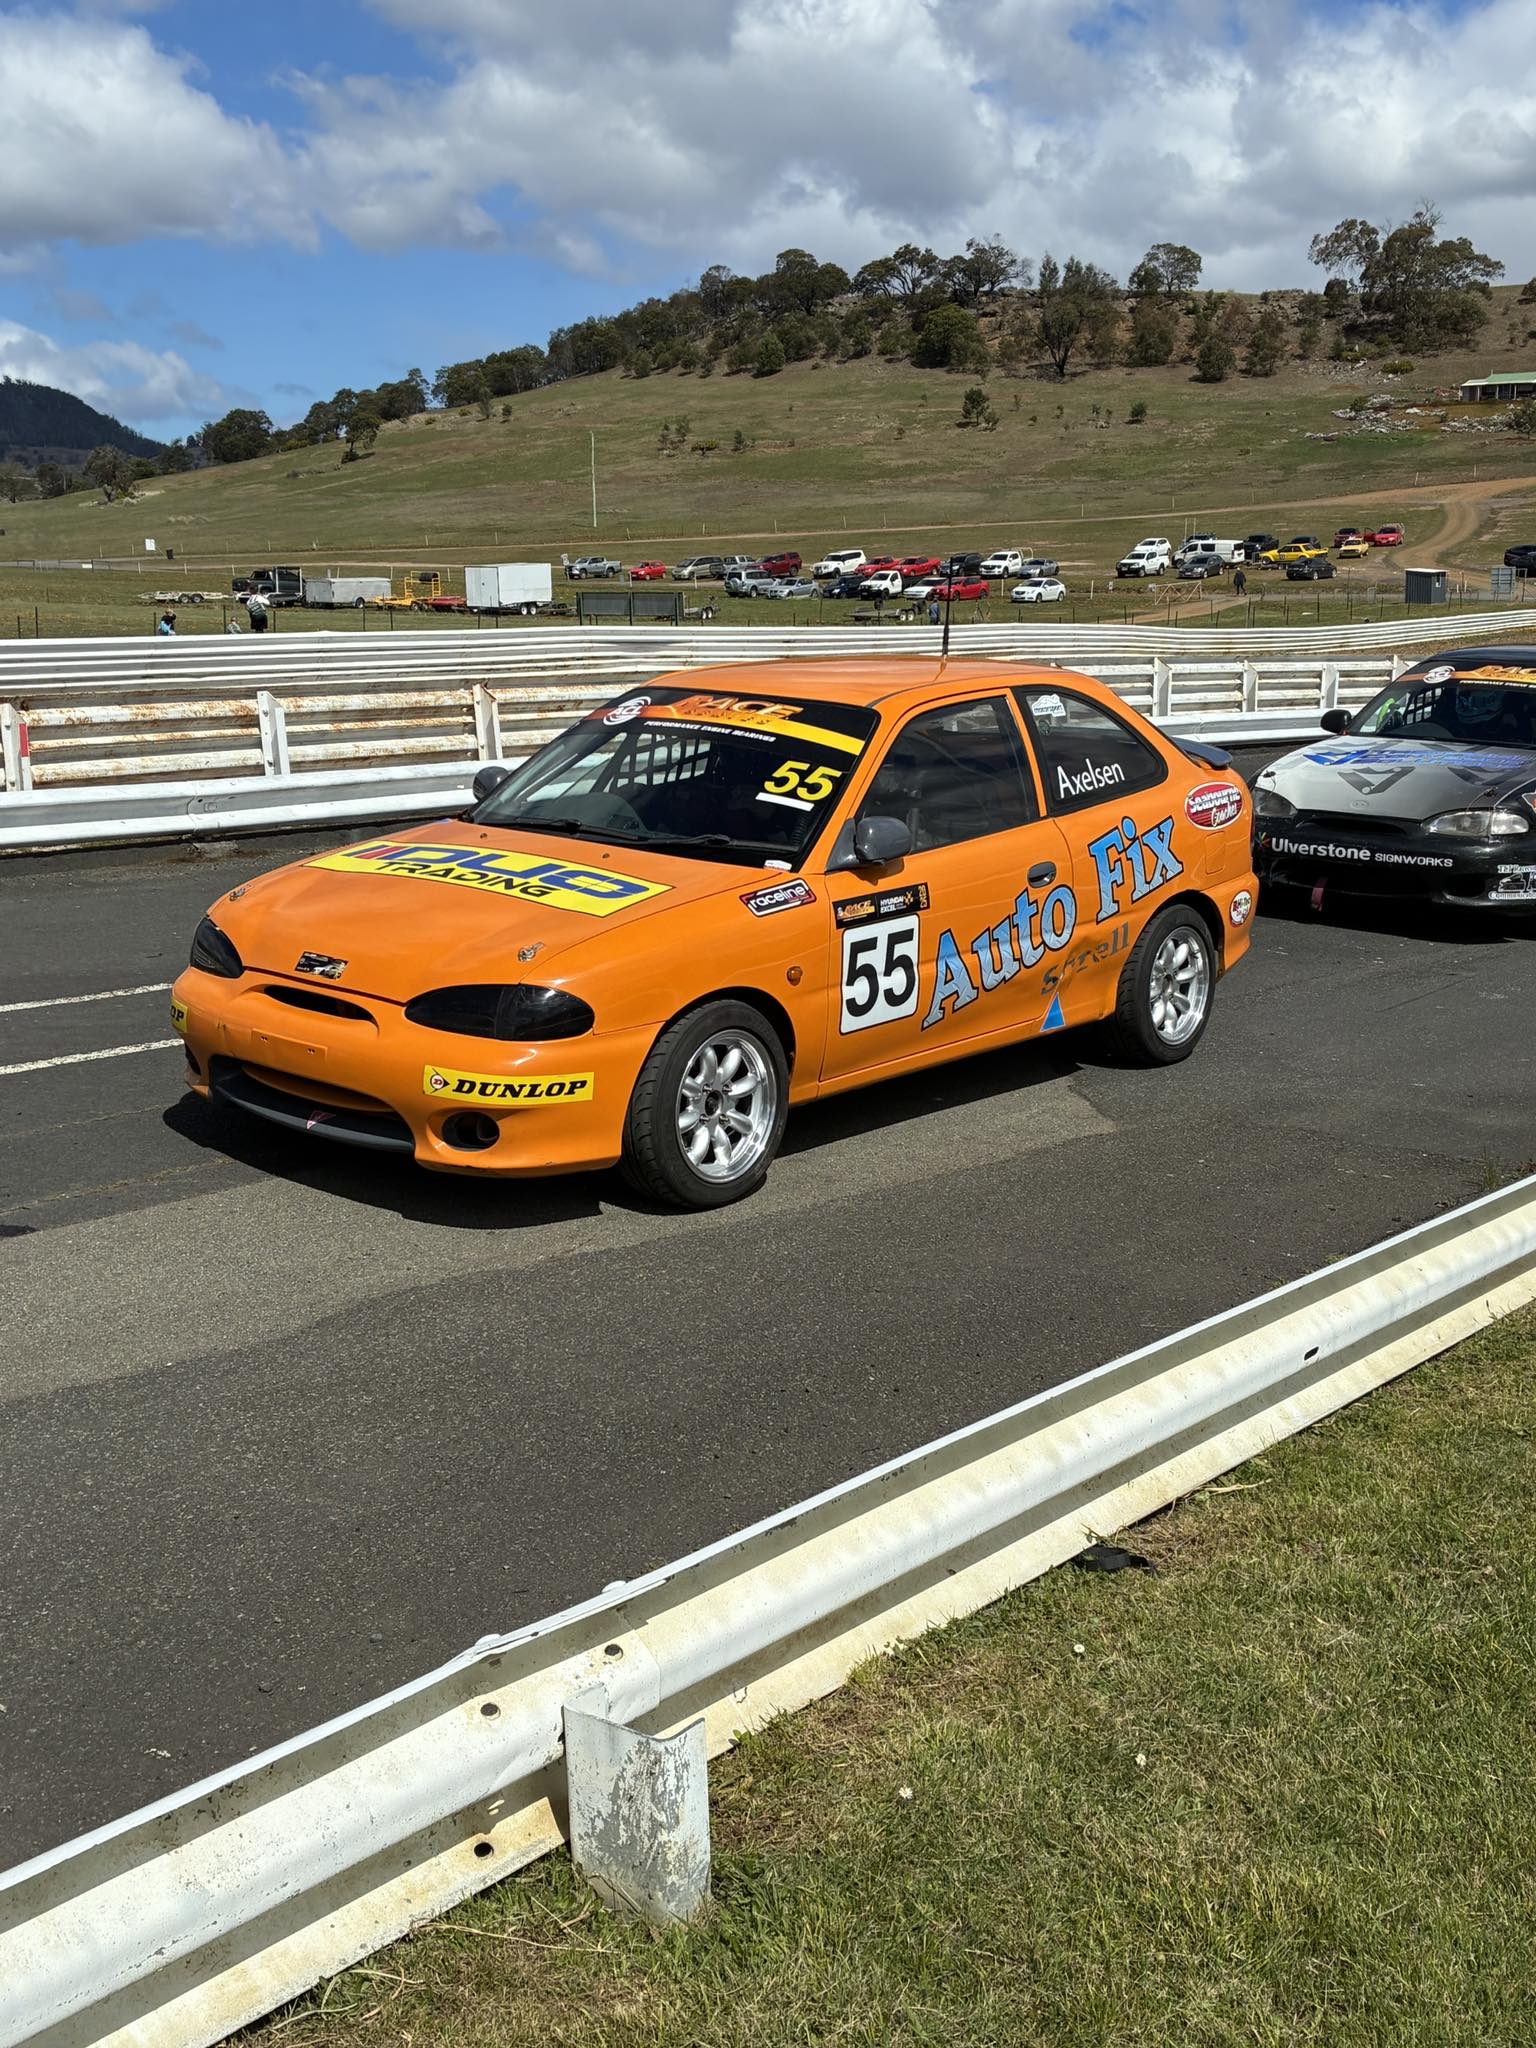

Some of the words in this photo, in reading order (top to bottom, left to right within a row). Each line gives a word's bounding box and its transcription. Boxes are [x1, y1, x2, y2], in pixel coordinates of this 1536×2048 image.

[607, 705, 642, 716] ACL
[680, 695, 804, 719] RACE
[644, 721, 702, 730] PERFORMANCE
[701, 725, 733, 734] ENGINE
[731, 730, 776, 742] BEARINGS
[764, 760, 842, 801] 55
[1057, 758, 1125, 799] Axelsen
[1271, 837, 1371, 860] Ulverstone
[1375, 852, 1454, 867] SIGNWORKS
[375, 861, 561, 898] TRADING
[380, 847, 650, 899] DUO
[750, 886, 806, 908] raceline
[880, 895, 904, 906] HYUNDAI
[880, 904, 897, 914] EXCEL
[921, 883, 1078, 1031] Auto
[1087, 815, 1184, 924] Fix
[845, 928, 916, 1017] 55
[452, 1079, 588, 1098] DUNLOP
